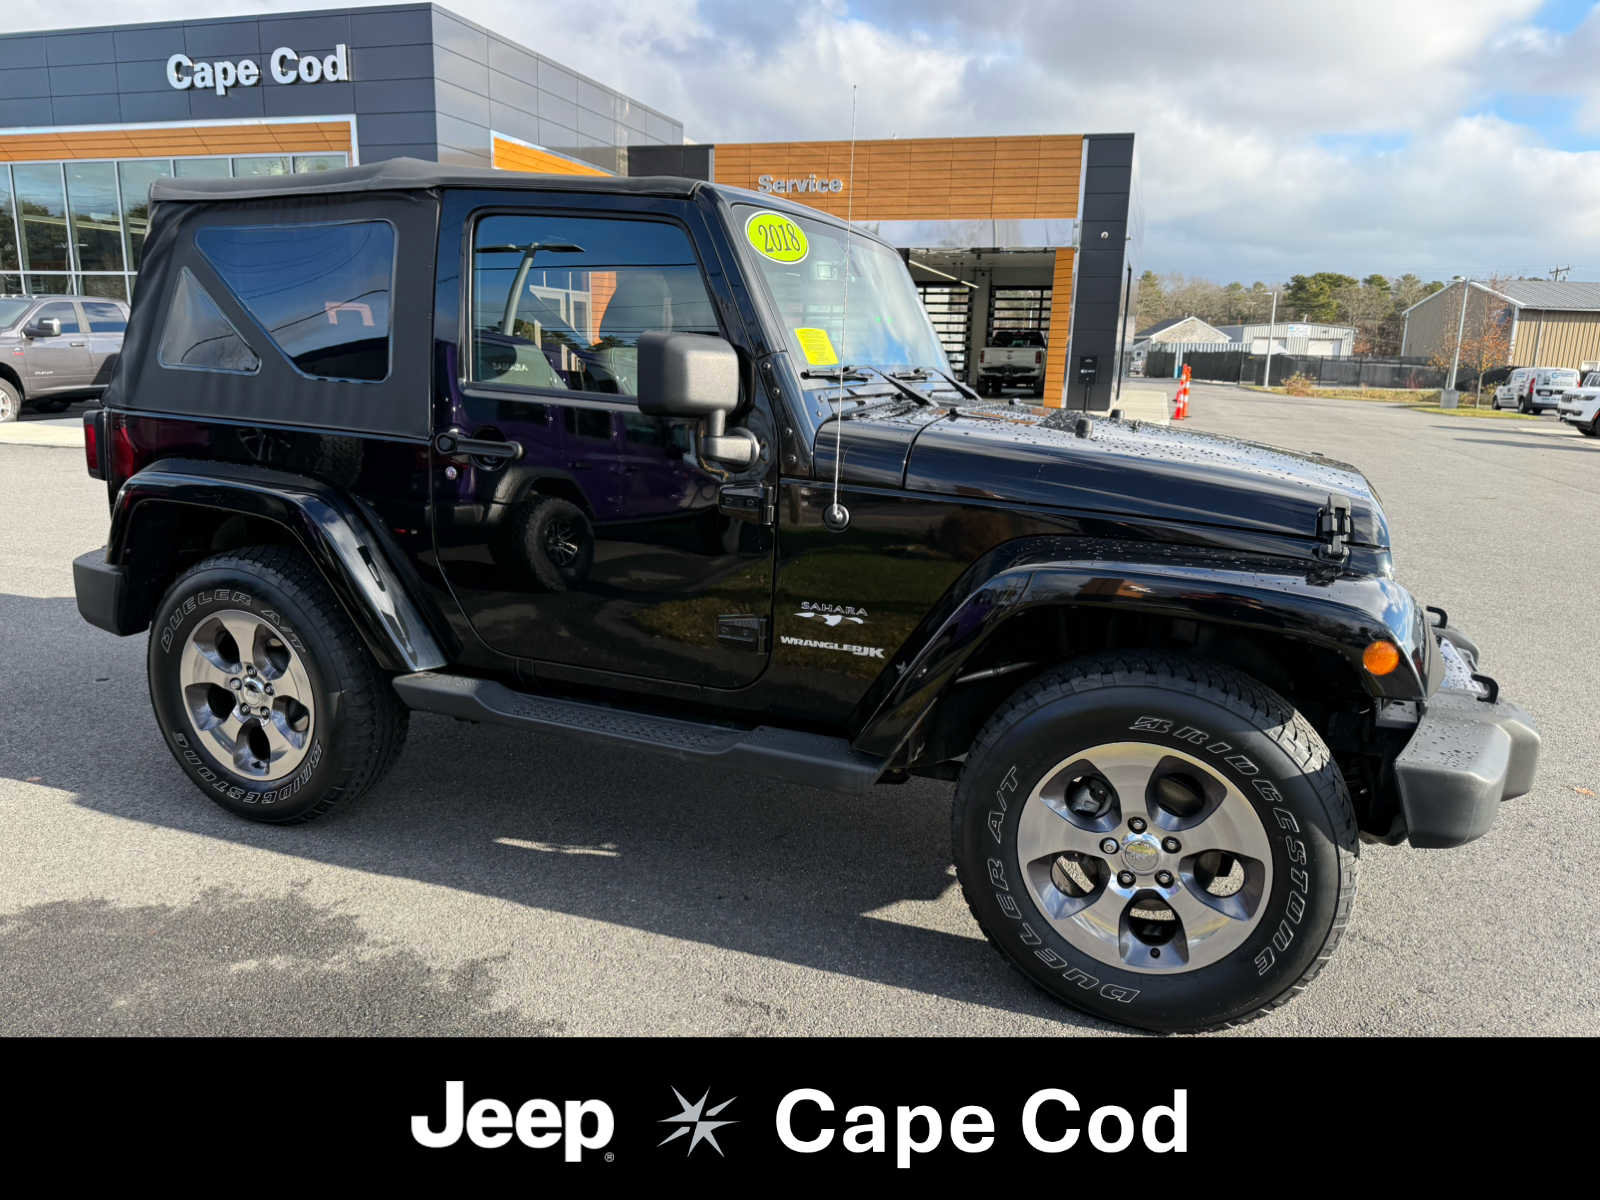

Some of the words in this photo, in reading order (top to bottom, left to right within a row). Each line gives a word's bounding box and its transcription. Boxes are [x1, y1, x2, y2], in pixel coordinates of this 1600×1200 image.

[166, 53, 262, 96] Cape
[271, 43, 349, 84] Cod
[757, 172, 844, 194] Service
[758, 223, 801, 253] 2018
[161, 589, 252, 653] DUELER
[800, 601, 868, 616] SAHARA
[987, 765, 1018, 844] A/T
[1128, 715, 1309, 976] BRIDGESTONE
[987, 857, 1142, 1004] DUELER
